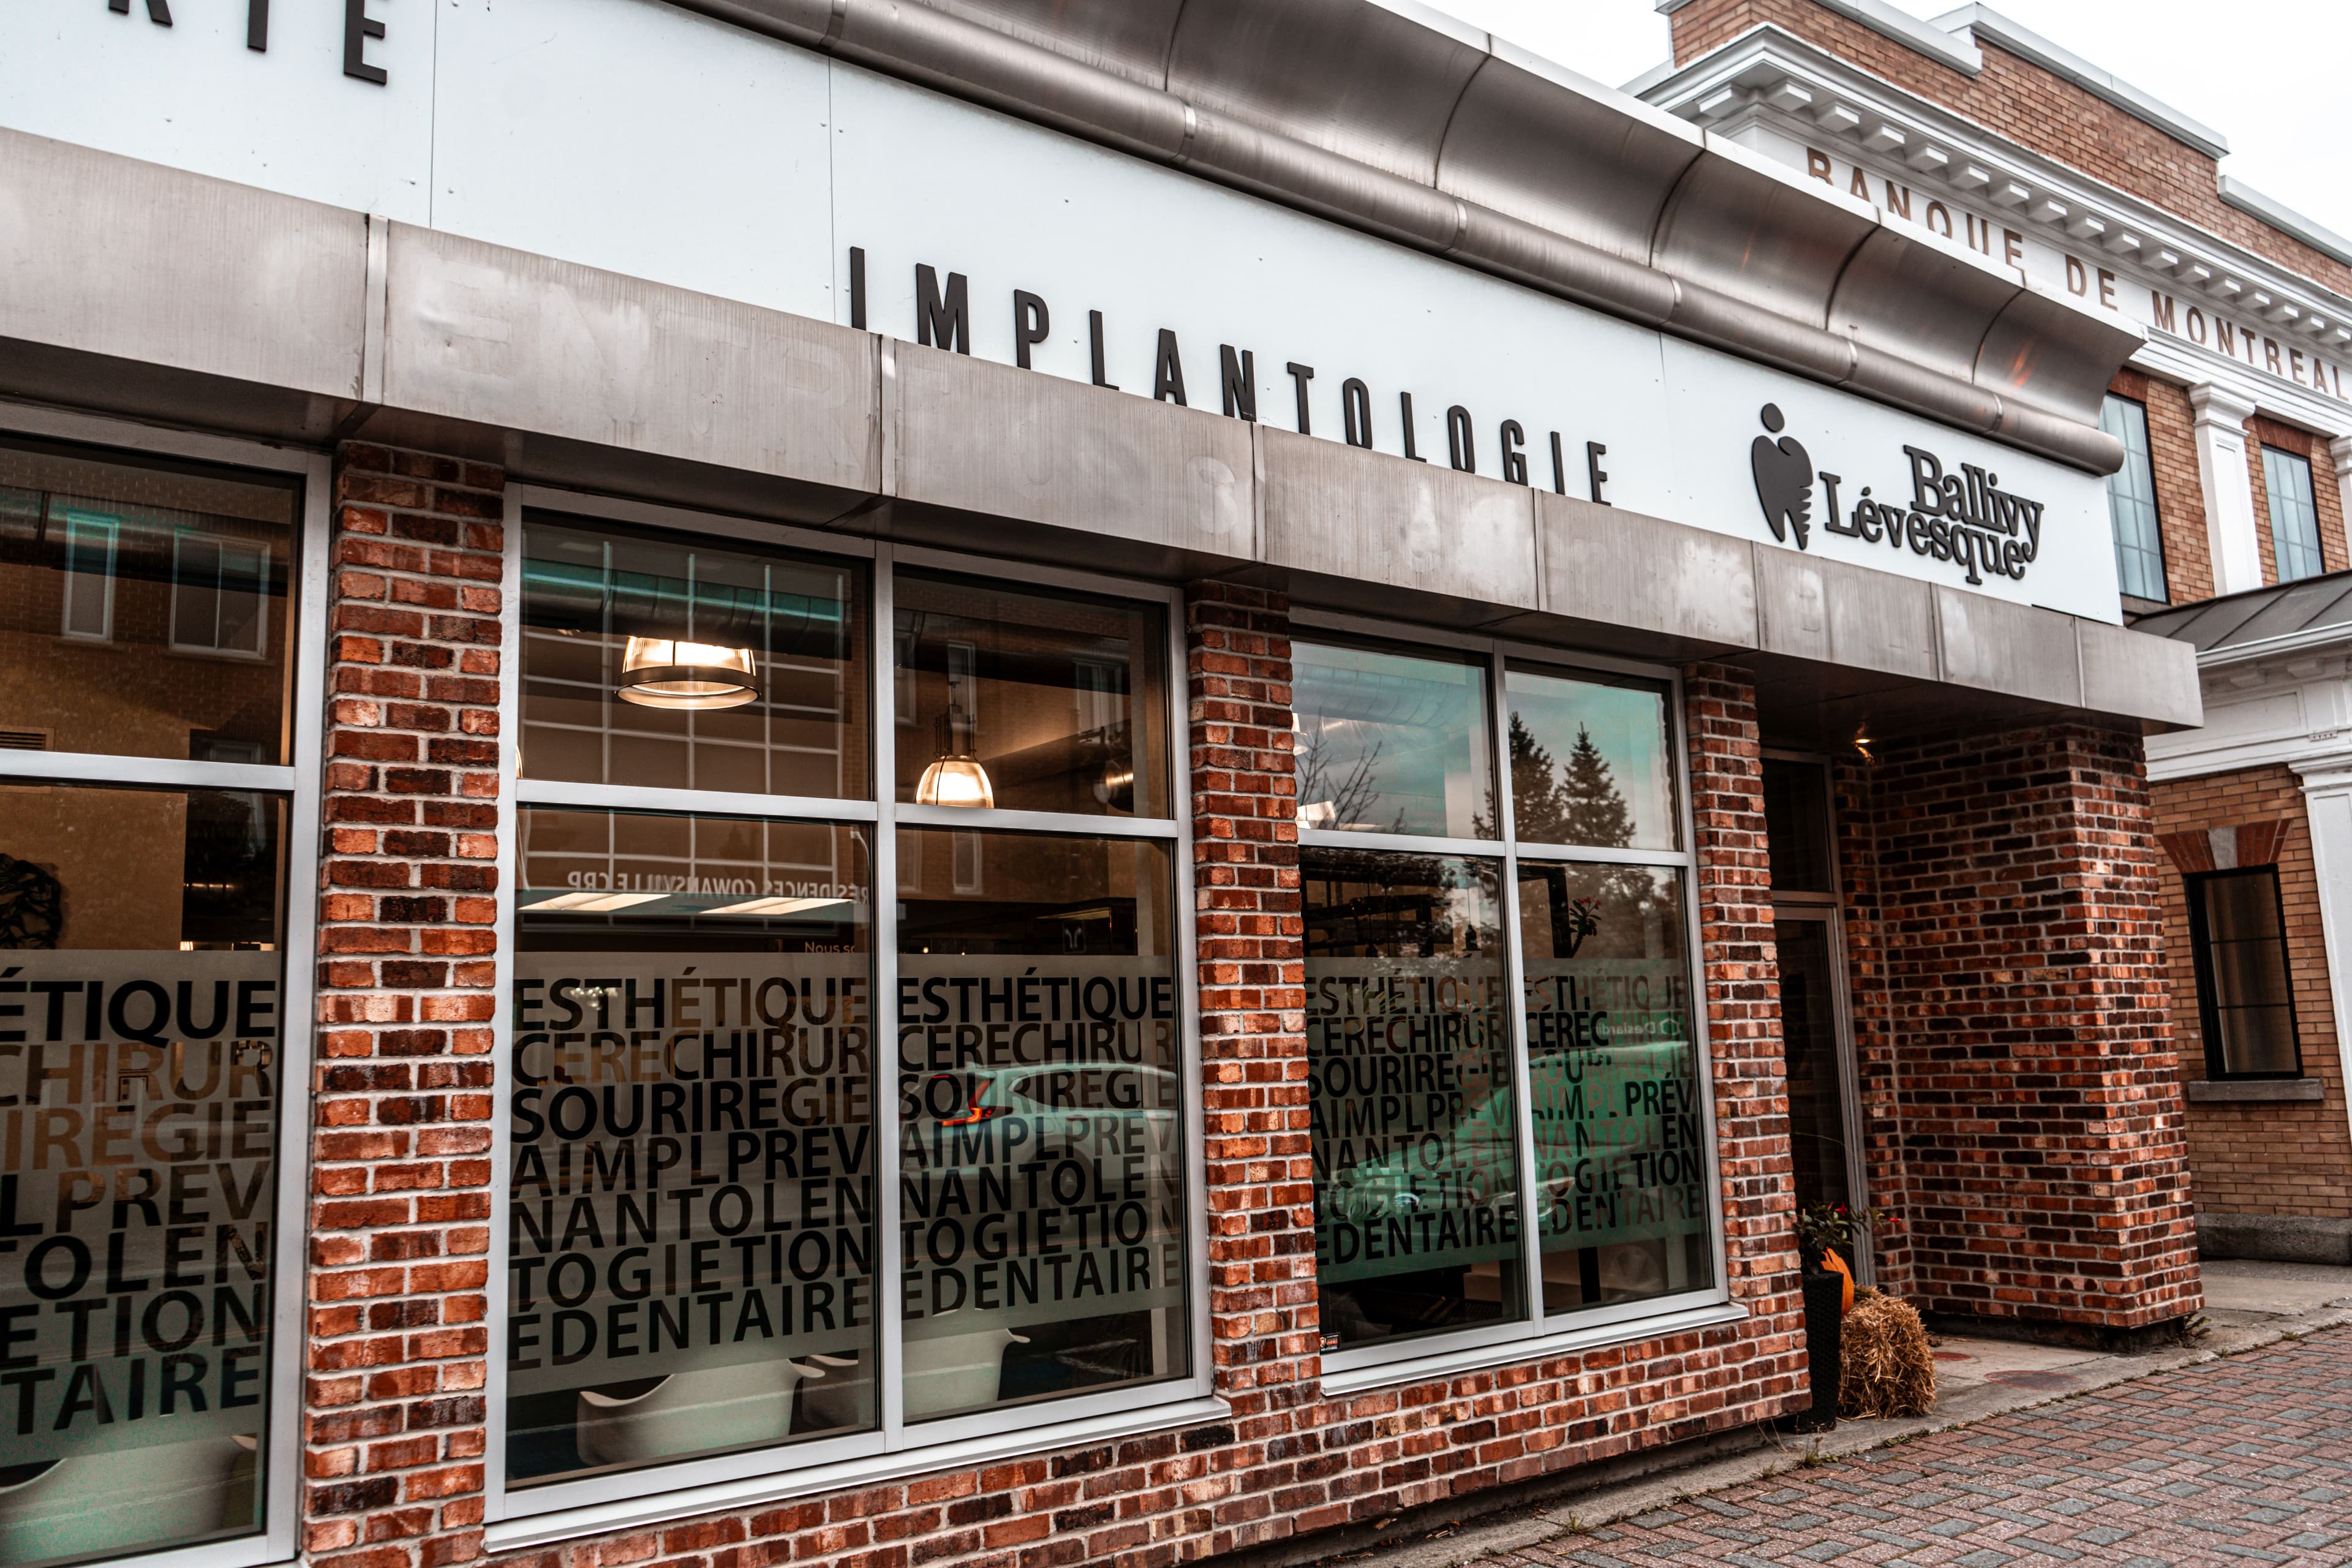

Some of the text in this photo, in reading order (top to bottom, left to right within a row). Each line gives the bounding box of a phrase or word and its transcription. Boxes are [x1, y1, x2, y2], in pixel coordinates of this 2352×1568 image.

[1807, 146, 2350, 403] BANQUE DE MONTREAL
[850, 246, 1611, 507] IMPLANTOLOGIE
[1819, 471, 2024, 585] Lévesque
[1904, 445, 2045, 562] Ballivy
[513, 967, 869, 1031] ESTHÉTIQUE
[897, 967, 1173, 1025] ESTHÉTIQUE
